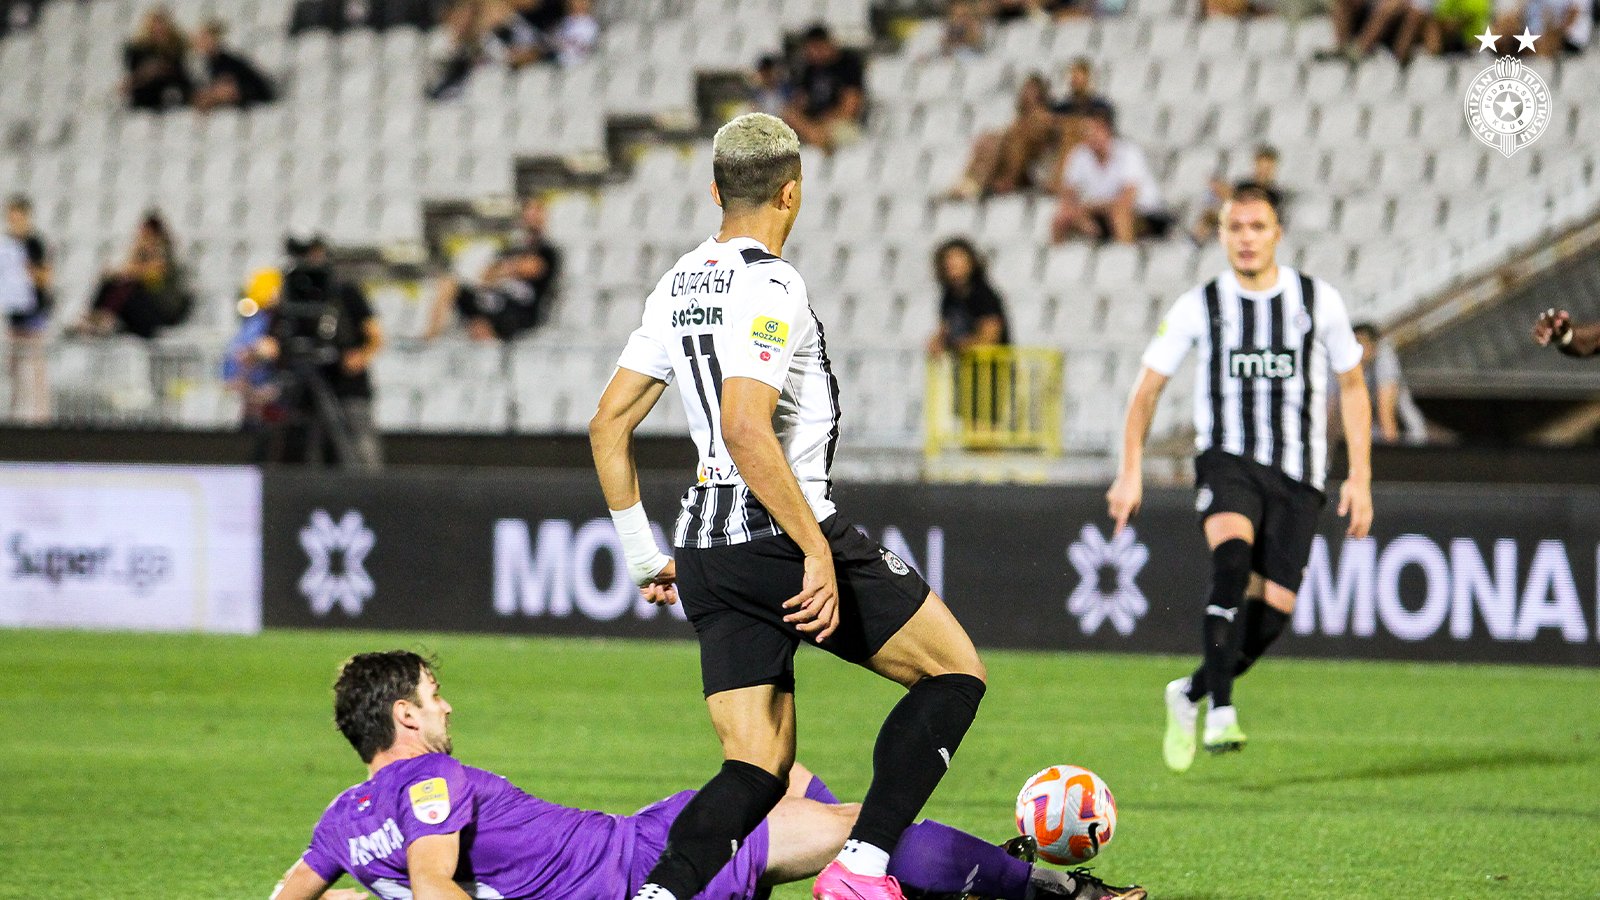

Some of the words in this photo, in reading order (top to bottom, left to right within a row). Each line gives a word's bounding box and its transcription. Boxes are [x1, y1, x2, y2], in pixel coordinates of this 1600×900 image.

[752, 331, 785, 345] MOZZART
[1231, 351, 1293, 378] mts
[682, 334, 723, 457] 11
[1292, 533, 1600, 643] MONA
